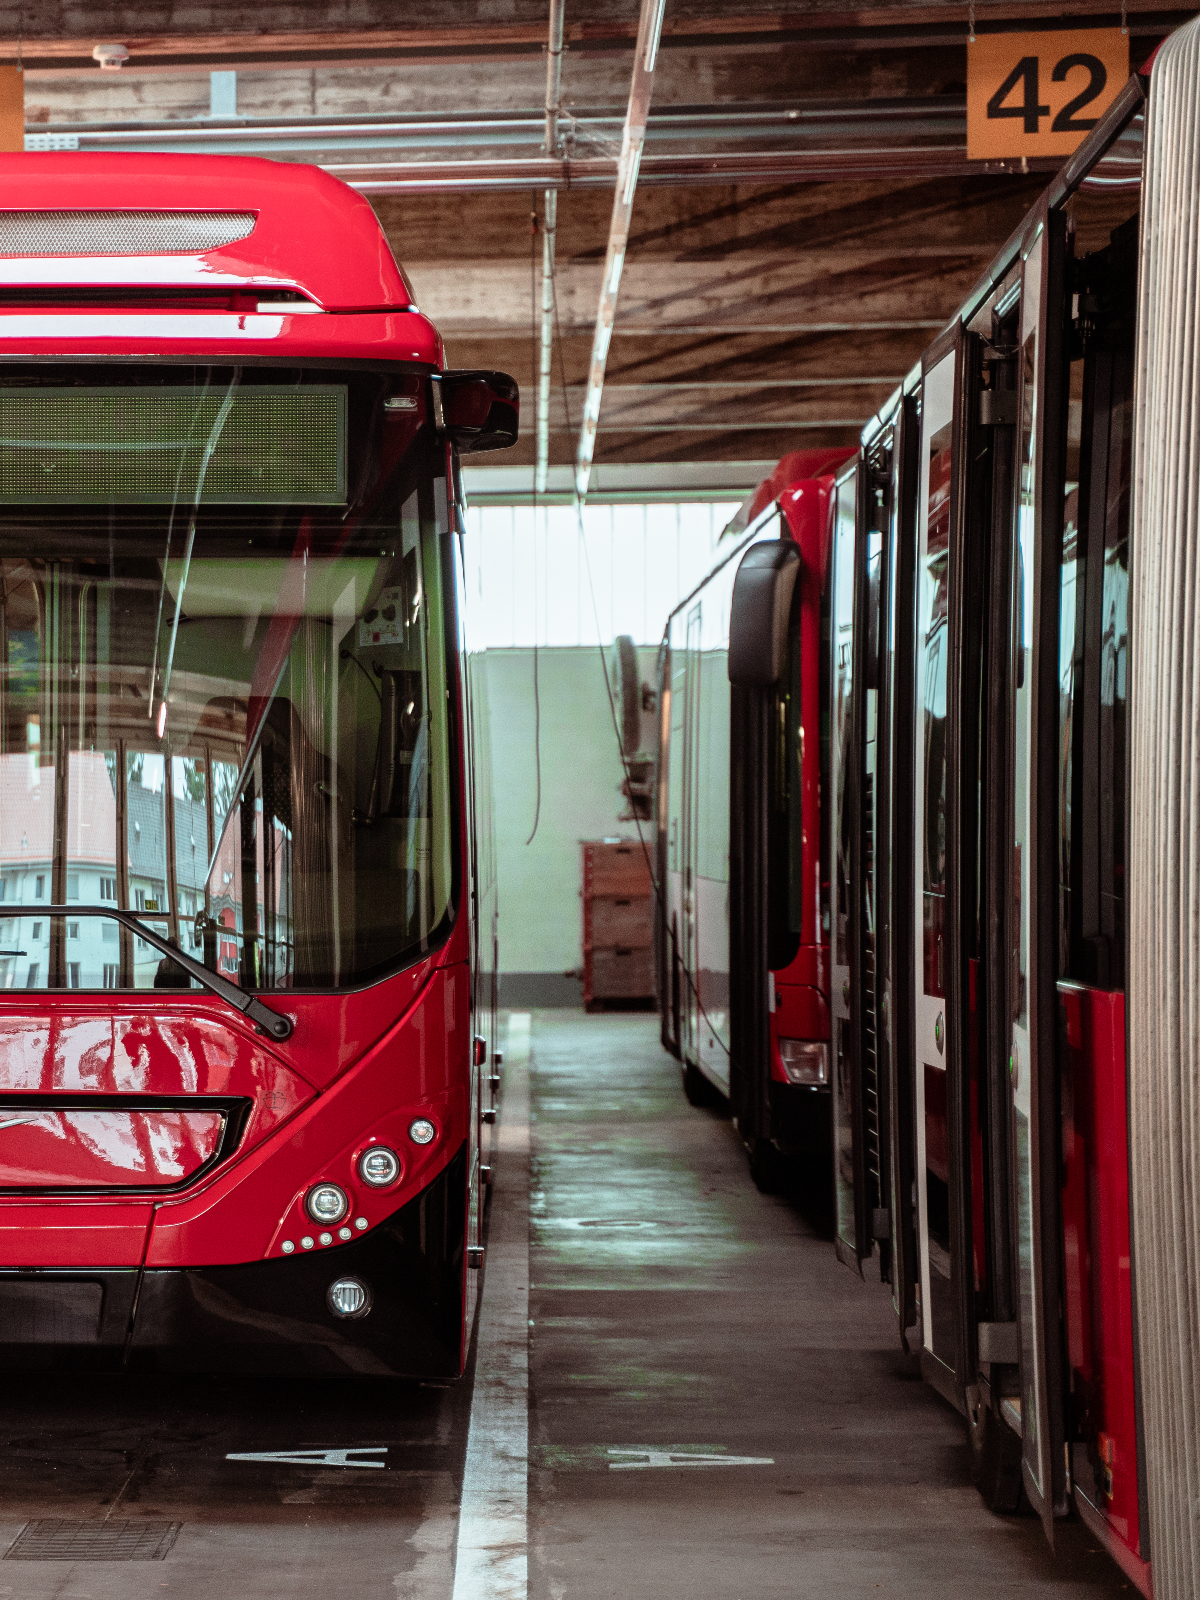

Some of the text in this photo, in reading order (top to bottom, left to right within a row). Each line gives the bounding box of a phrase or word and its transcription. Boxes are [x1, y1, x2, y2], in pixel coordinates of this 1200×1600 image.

[987, 53, 1107, 134] 42
[225, 1447, 388, 1468] A
[607, 1449, 775, 1469] A
